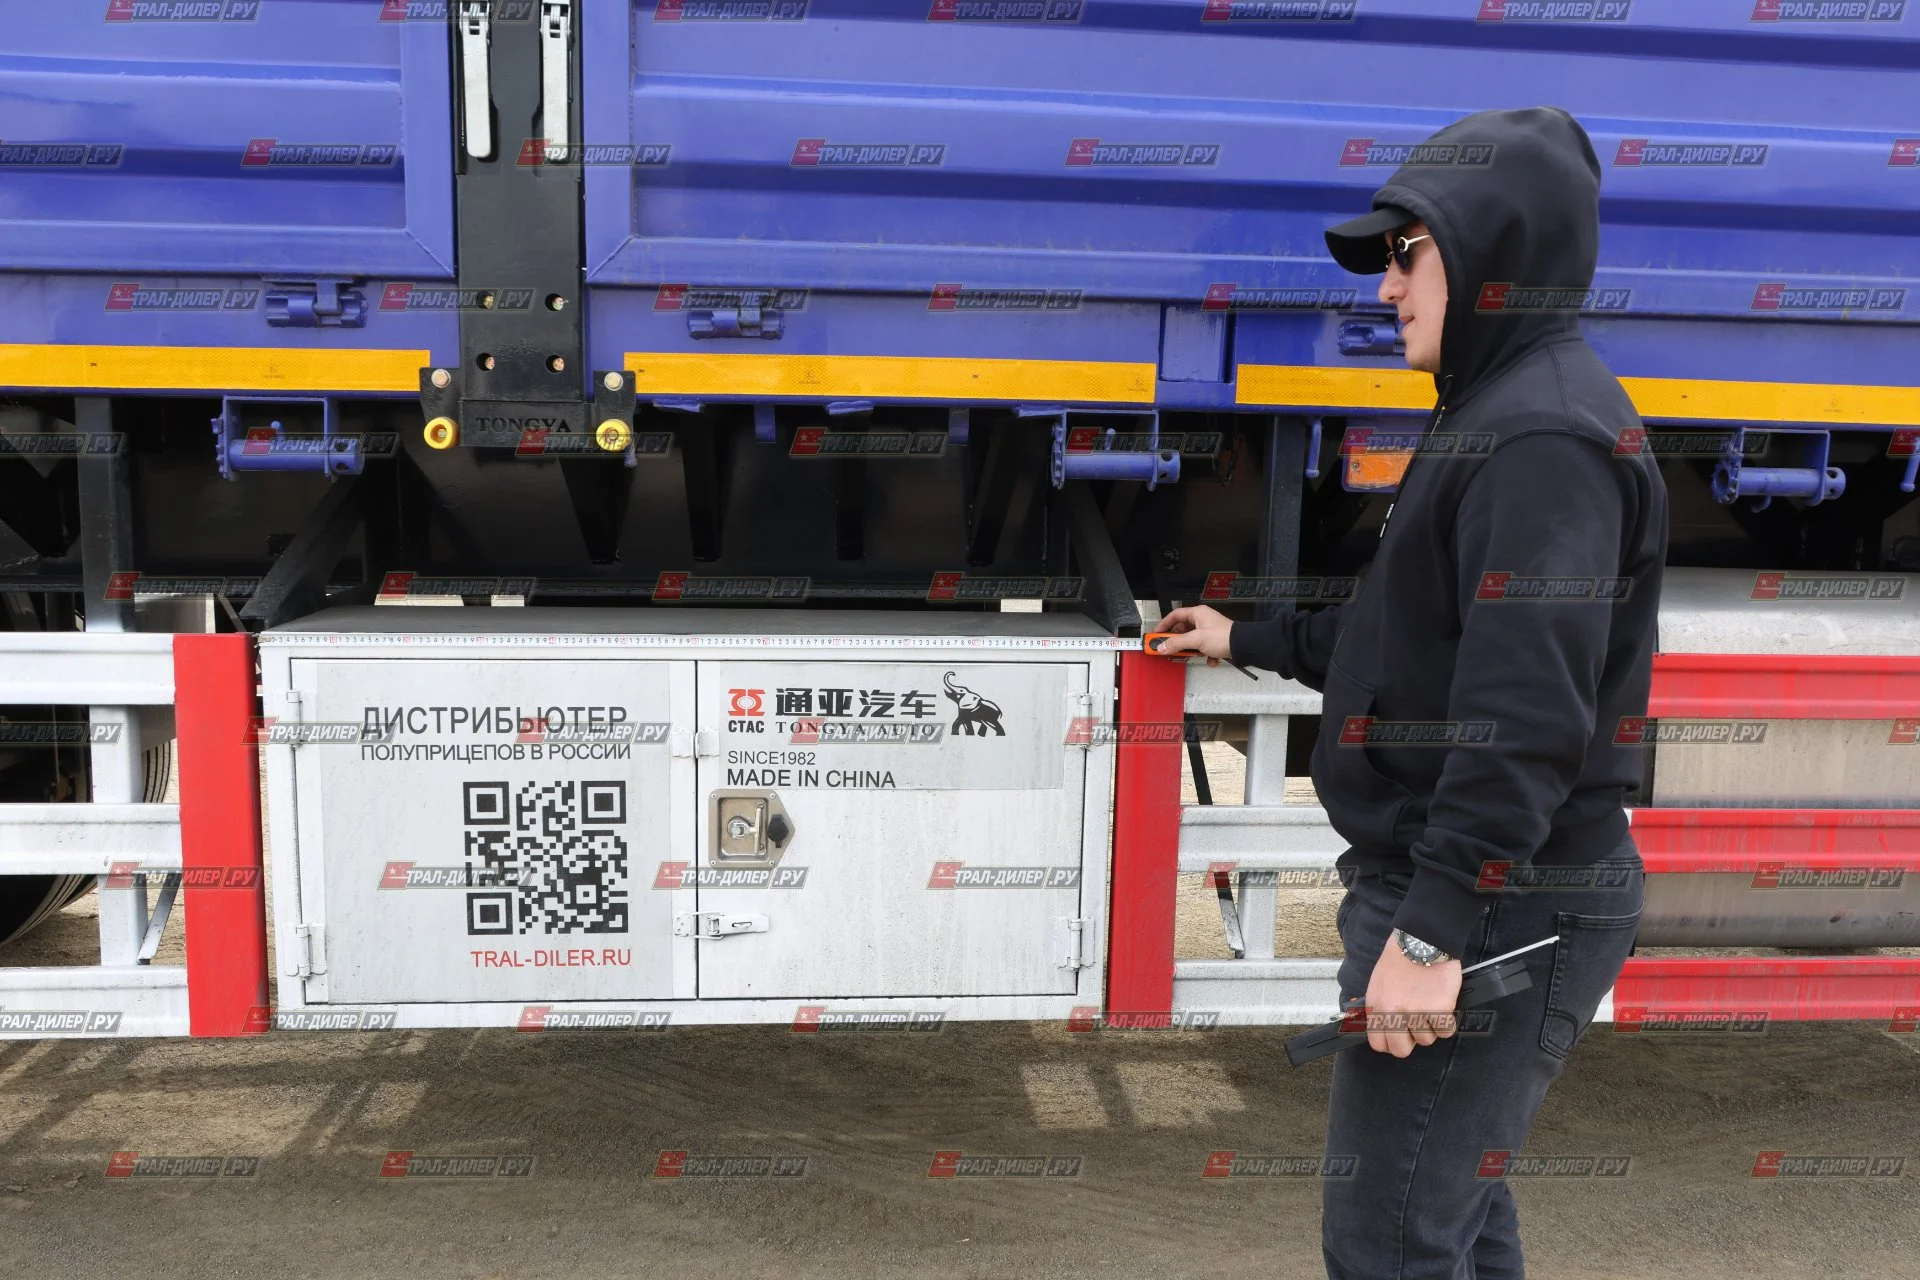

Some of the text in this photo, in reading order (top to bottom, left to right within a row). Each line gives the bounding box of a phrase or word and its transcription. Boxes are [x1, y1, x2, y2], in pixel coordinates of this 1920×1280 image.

[475, 417, 572, 433] TONGYA
[775, 687, 937, 719] 通亚汽车
[361, 706, 628, 740] ДИСТРИБЬЮТЕР
[727, 719, 765, 734] CTAC
[775, 719, 937, 738] TONGYA AUTO
[361, 743, 632, 765] ПОЛУПРИЦЕПОВ В РОССИИ
[727, 750, 816, 766] SINCE1982
[727, 768, 897, 789] MADE IN CHINA
[470, 948, 632, 968] TRAL-DILER.RU
